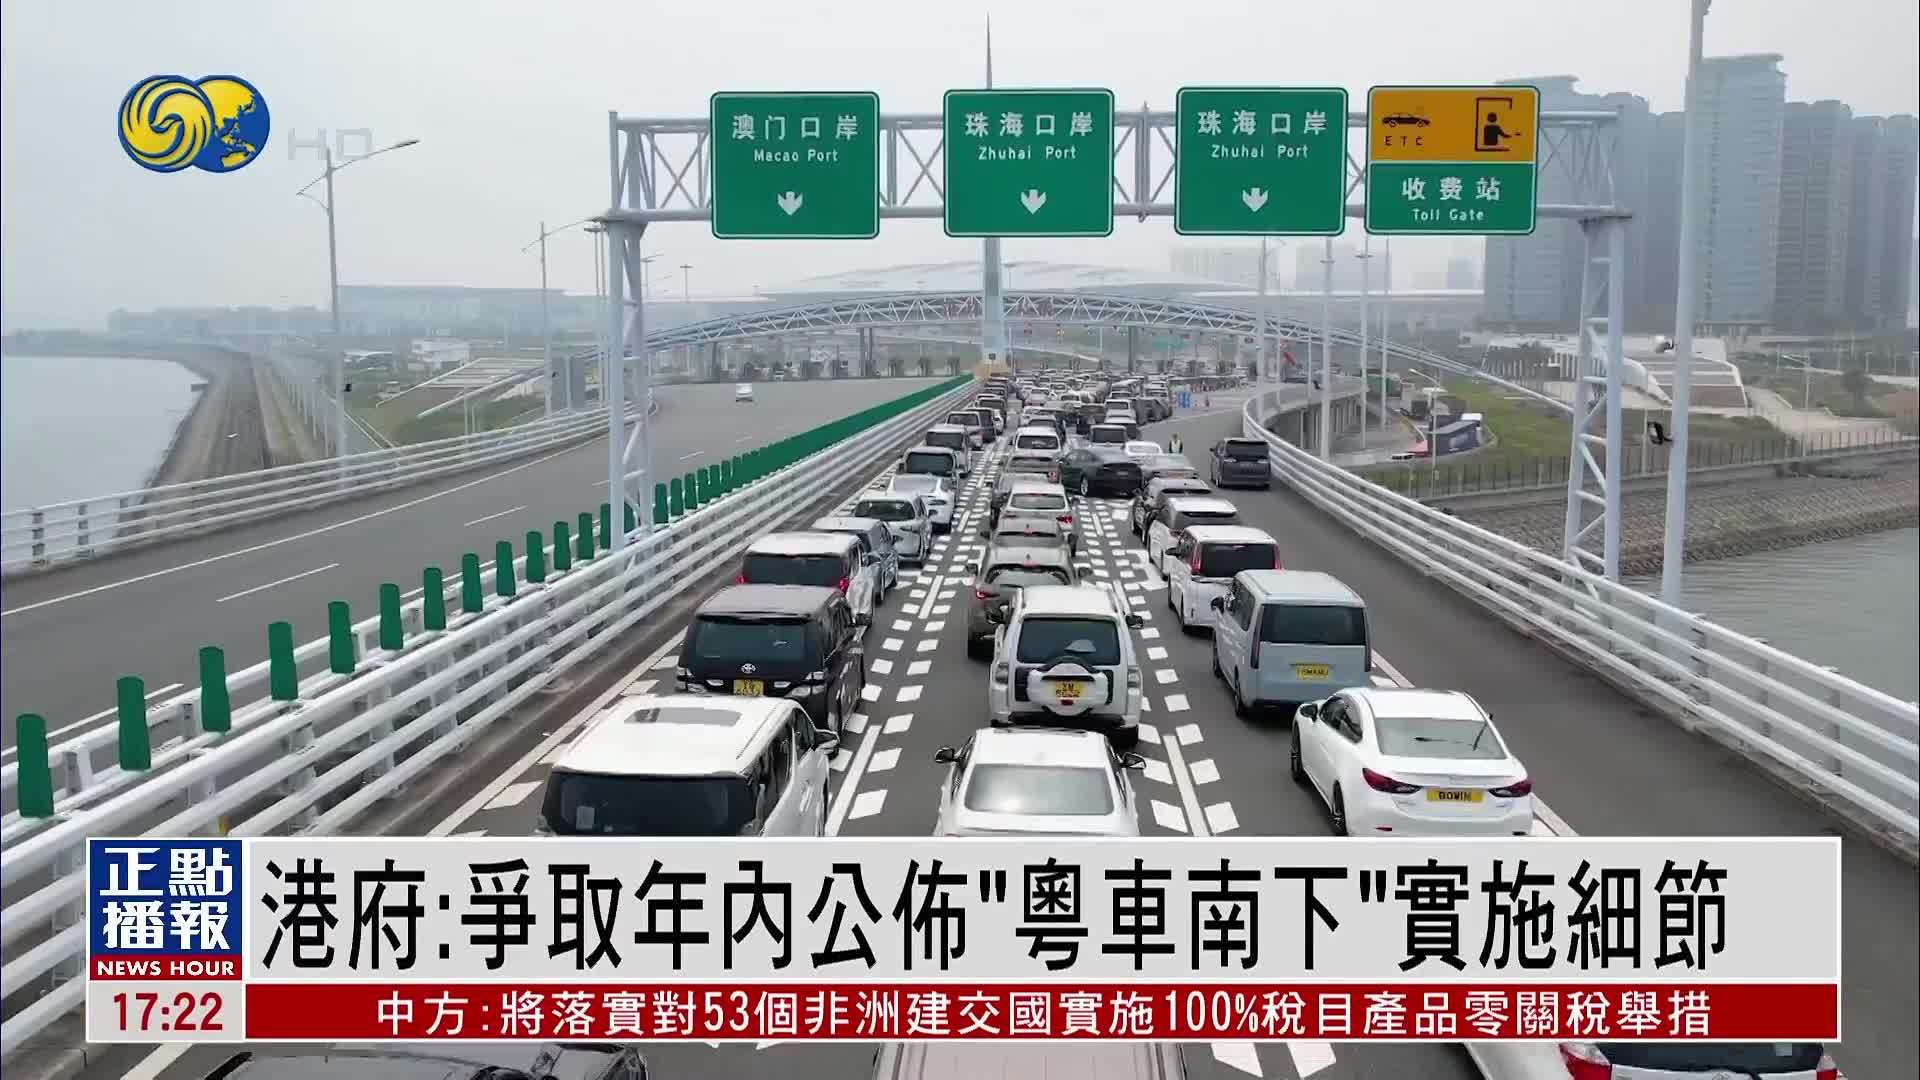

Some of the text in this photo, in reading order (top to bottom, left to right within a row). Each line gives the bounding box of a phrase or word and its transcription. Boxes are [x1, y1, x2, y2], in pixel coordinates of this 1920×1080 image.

[732, 113, 858, 140] 澳门口岸
[965, 111, 1093, 137] 珠海口岸
[1198, 109, 1327, 136] 珠海口岸
[754, 148, 838, 162] Macao Port
[978, 145, 1076, 160] Zhuhai Port
[1211, 144, 1308, 158] Zhuhai Port
[1402, 176, 1501, 201] 收费站
[1413, 208, 1484, 221] Toll Gate
